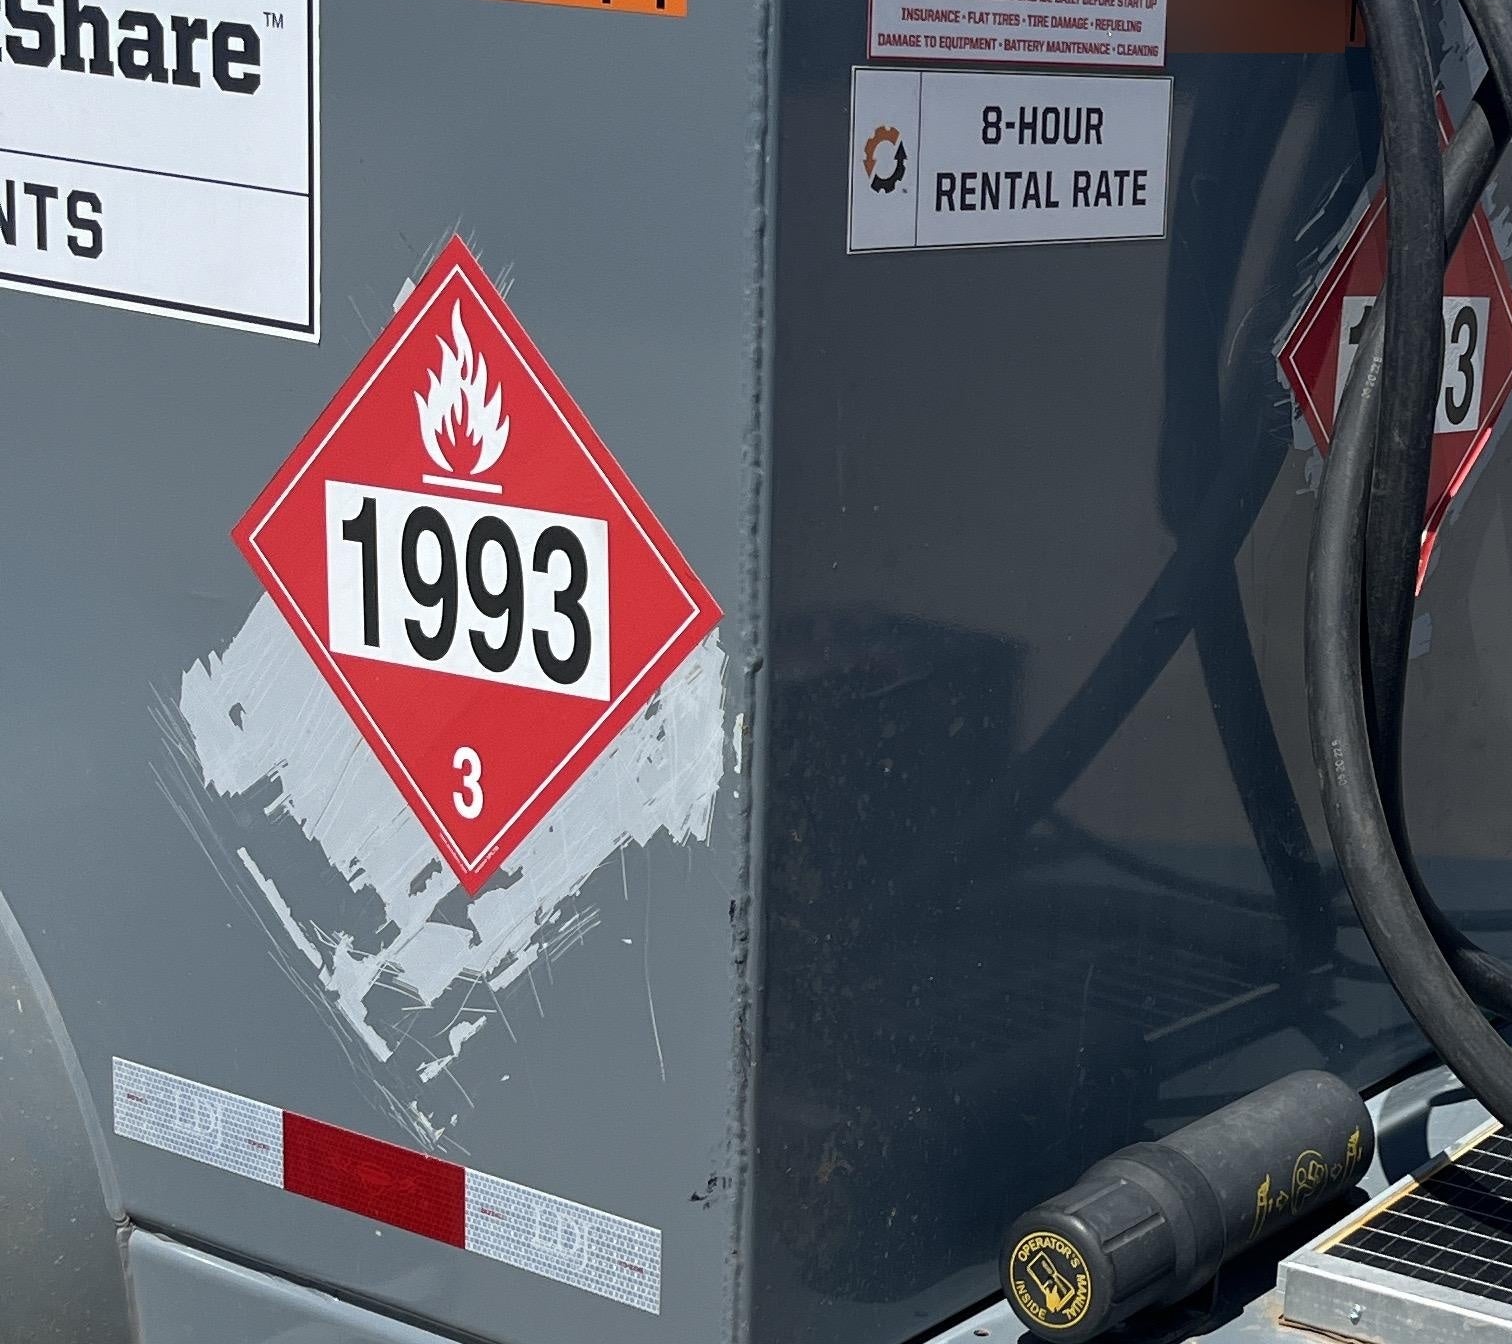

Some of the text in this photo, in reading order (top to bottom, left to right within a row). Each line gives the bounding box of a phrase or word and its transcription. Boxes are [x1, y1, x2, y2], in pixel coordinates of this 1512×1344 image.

[901, 7, 1142, 33] INSURANCE FLAT TIRES TIRE DAMAGE REFUELING
[878, 32, 1158, 57] DAMAGE TO EQUIPMENT BATTERY MAINTENANCE CLEANING
[980, 106, 1104, 146] 8-HOUR
[934, 168, 1148, 214] RENTAL RATE
[342, 496, 592, 686] 1993
[452, 746, 484, 819] 3
[1015, 1279, 1047, 1321] INSIDE
[1018, 1237, 1088, 1320] OPERATOR'S MANUAL
